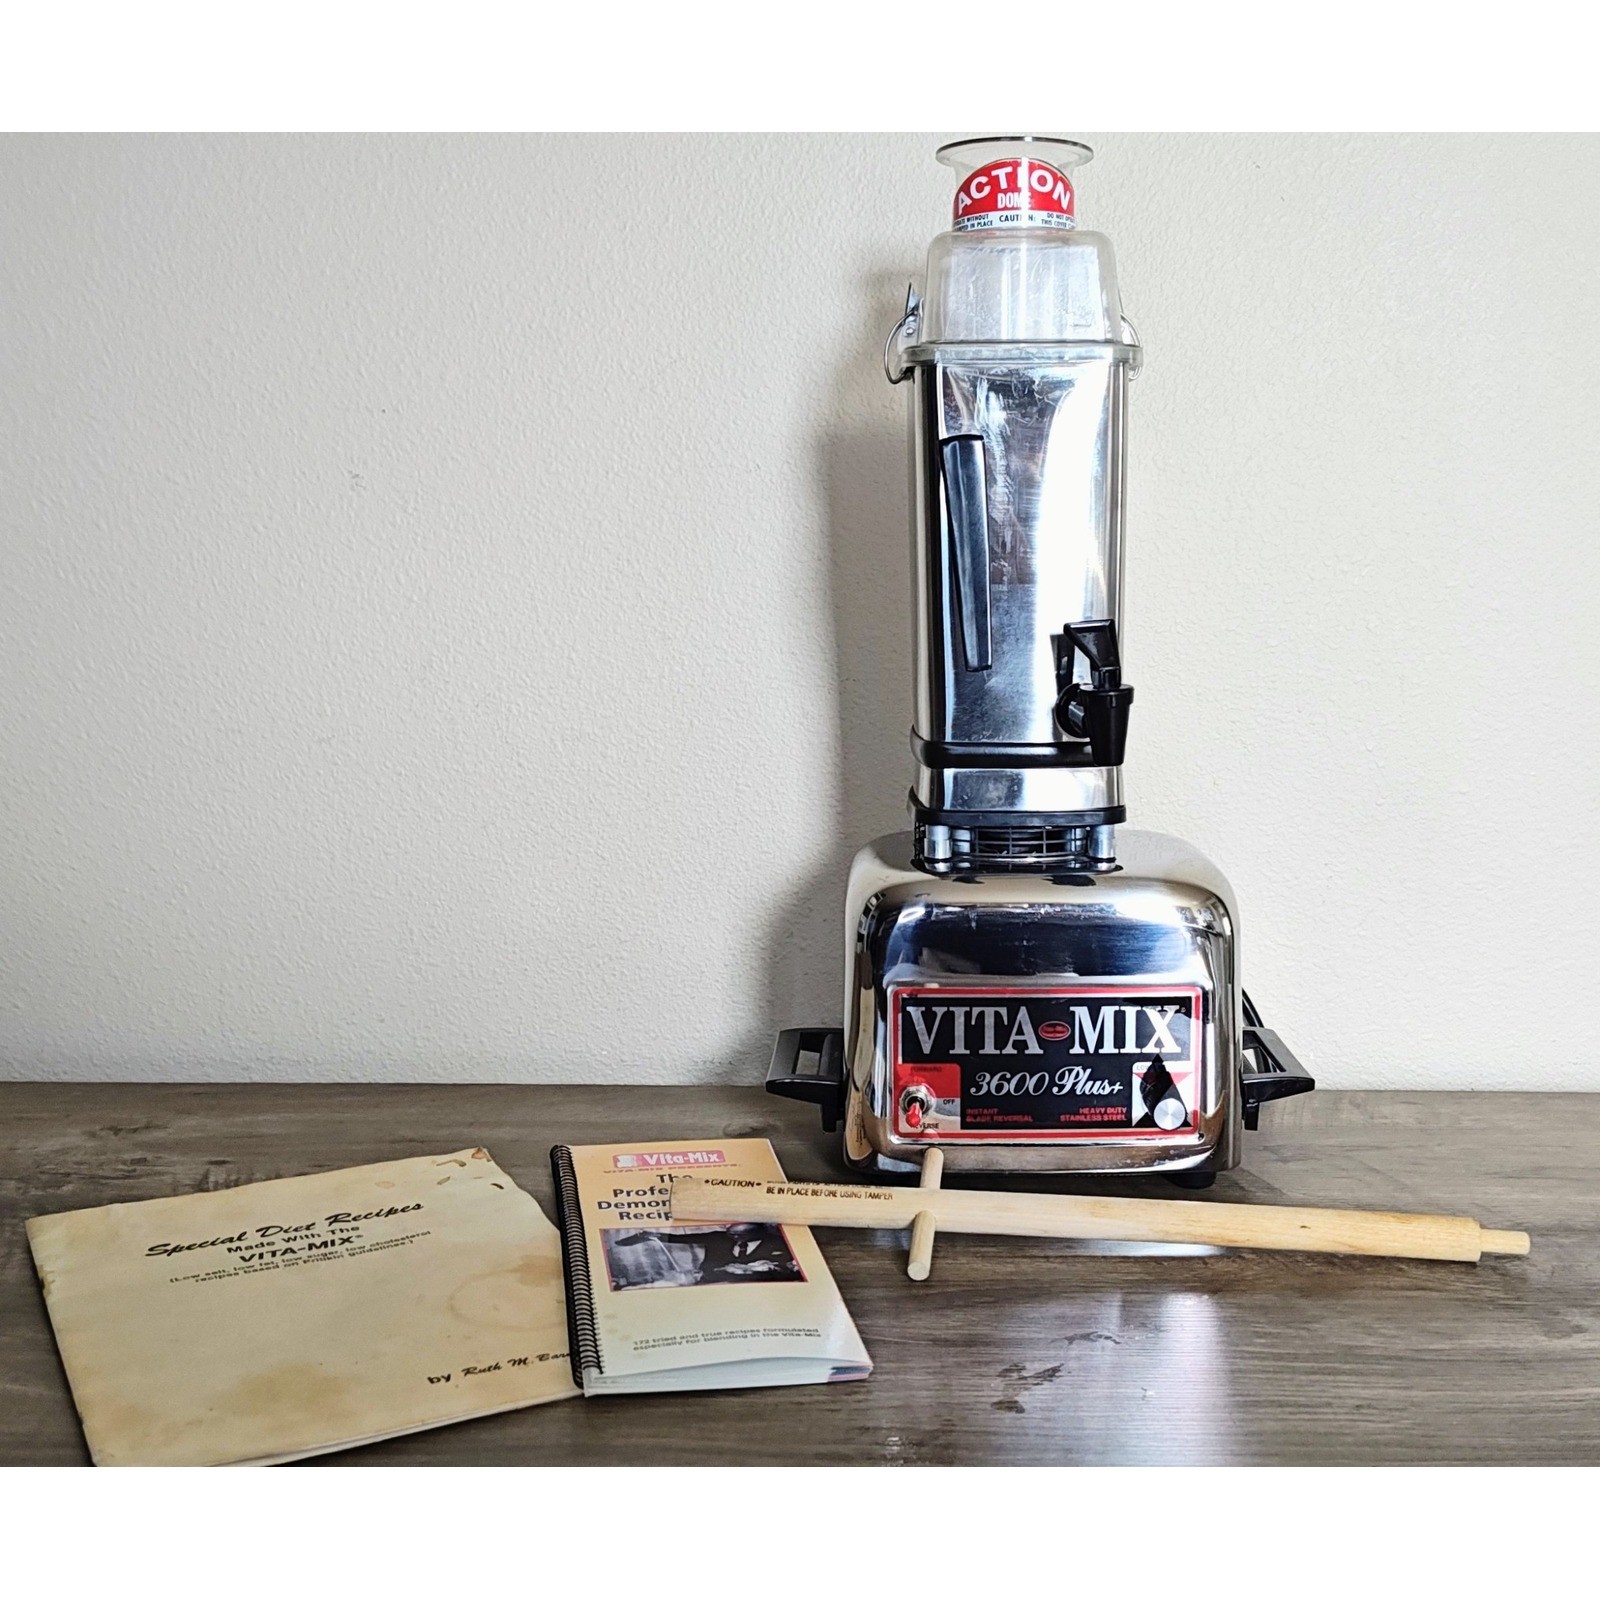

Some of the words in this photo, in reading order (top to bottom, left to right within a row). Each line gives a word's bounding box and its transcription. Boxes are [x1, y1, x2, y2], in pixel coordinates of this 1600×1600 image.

[958, 166, 1071, 215] ACTION
[977, 220, 993, 228] PLACE
[906, 1005, 1044, 1055] VITA
[1069, 1004, 1182, 1054] MIX
[969, 1071, 1050, 1097] 3600
[1052, 1065, 1124, 1096] Plus+
[942, 1098, 956, 1106] OFF
[1060, 1114, 1102, 1122] STAINLESS
[643, 1152, 720, 1165] Vita-Mix
[766, 1186, 775, 1195] BE
[777, 1187, 785, 1195] IN
[786, 1188, 809, 1197] PLACE
[811, 1189, 838, 1198] BEFORE
[839, 1190, 862, 1199] USING
[864, 1191, 894, 1200] TAMPER
[144, 1231, 248, 1257] Special
[255, 1222, 316, 1238] Diet
[324, 1203, 424, 1227] Recipes
[226, 1240, 276, 1253] Made
[281, 1231, 322, 1243] With
[326, 1226, 360, 1235] The
[233, 1263, 255, 1271] low
[345, 1244, 366, 1253] low
[369, 1230, 432, 1247] cholesterol
[195, 1271, 240, 1282] recipes
[243, 1264, 280, 1274] based
[283, 1260, 300, 1268] on
[633, 1340, 683, 1350] especially
[703, 1334, 748, 1342] blending
[652, 1335, 677, 1343] tried
[426, 1373, 451, 1384] by
[460, 1362, 503, 1377] Ruth
